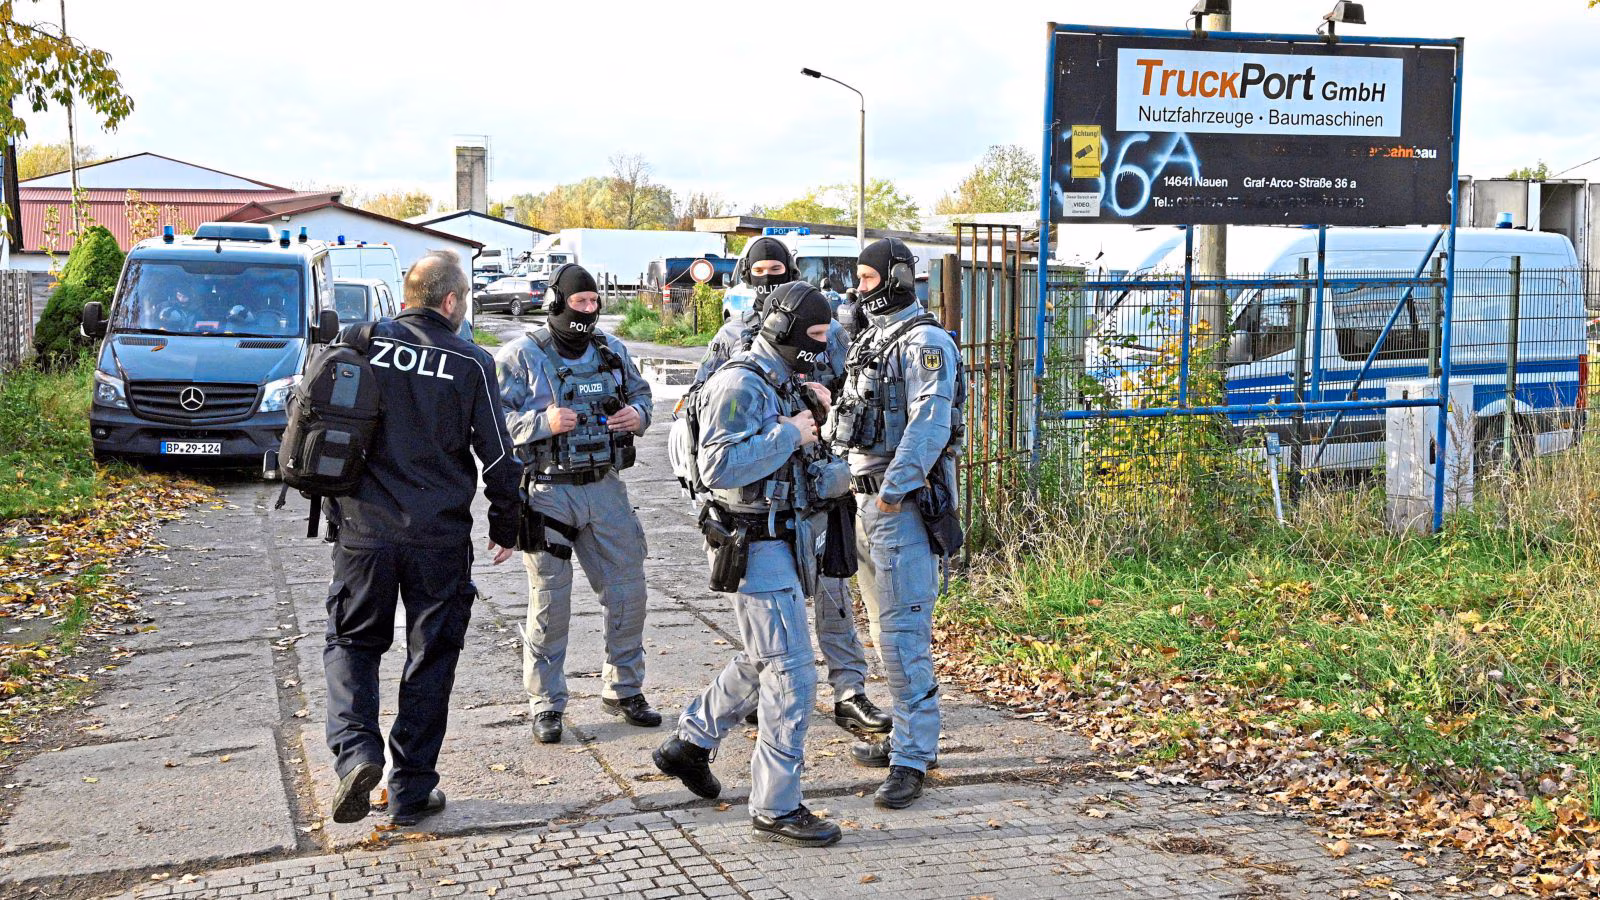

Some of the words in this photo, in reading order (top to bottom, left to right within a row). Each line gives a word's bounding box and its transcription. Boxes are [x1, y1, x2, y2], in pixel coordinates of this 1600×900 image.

[1136, 59, 1316, 100] TruckPort
[1321, 81, 1386, 102] GmbH
[1138, 105, 1254, 128] Nutzfahrzeuge
[1269, 109, 1383, 127] Baumaschinen
[1163, 176, 1193, 187] 14641
[1195, 177, 1228, 188] Nauen
[1334, 178, 1348, 189] 36
[1350, 180, 1357, 189] a
[1153, 196, 1174, 207] Tel.:
[866, 297, 888, 312] IZEI
[569, 321, 588, 333] POL
[369, 340, 454, 381] ZOLL
[796, 350, 817, 363] POL
[579, 383, 603, 394] POLIZEI
[166, 443, 180, 453] BP
